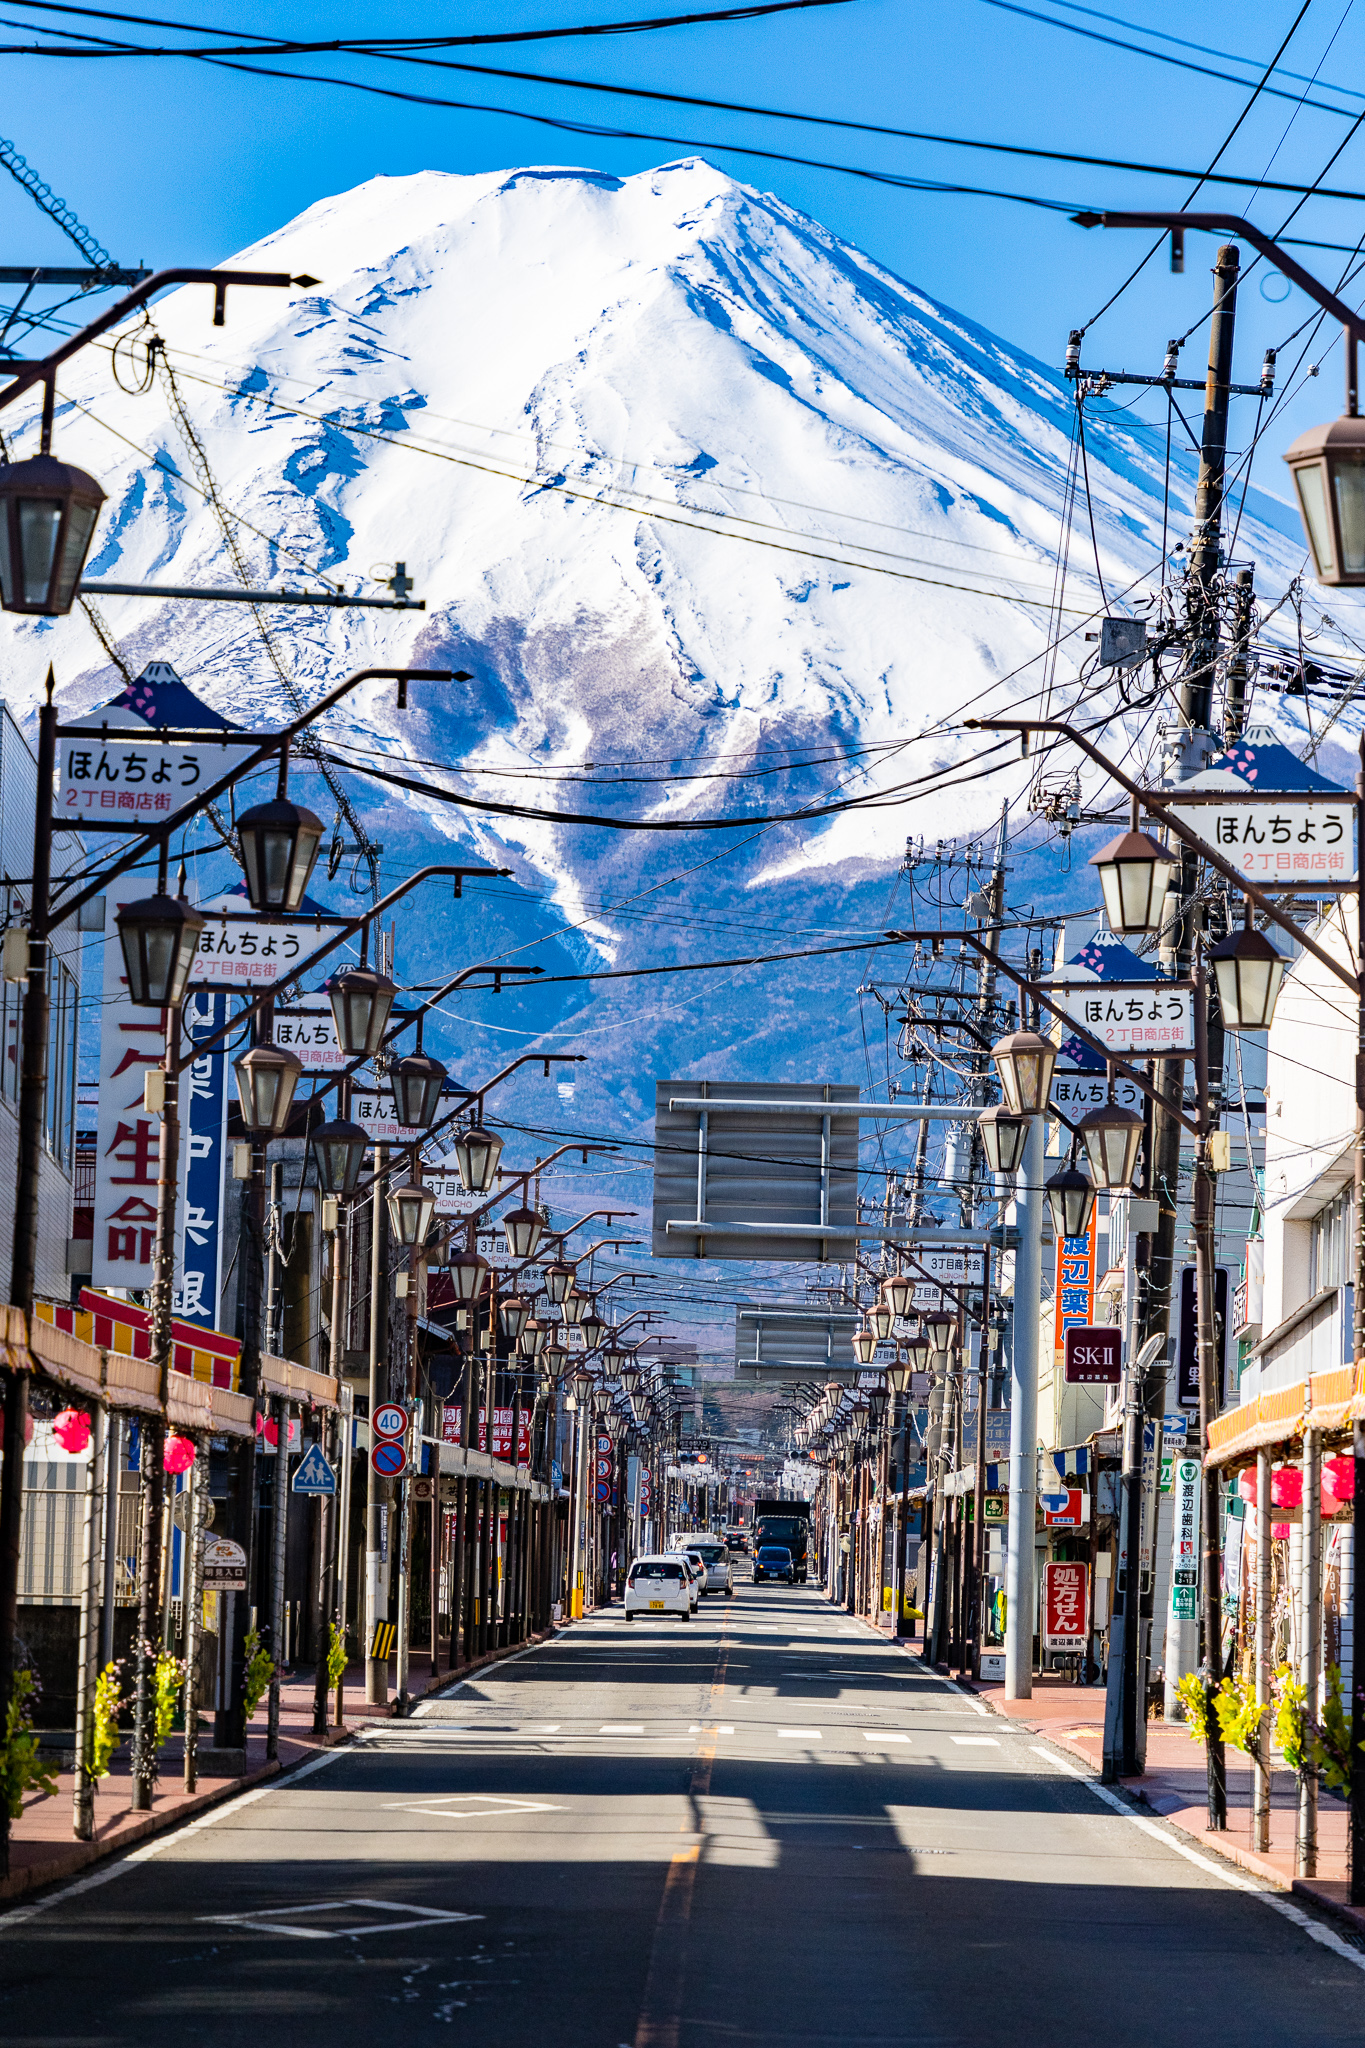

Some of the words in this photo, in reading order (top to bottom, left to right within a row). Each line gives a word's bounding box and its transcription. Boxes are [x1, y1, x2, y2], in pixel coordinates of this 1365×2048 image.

[68, 750, 201, 787] ほんちょう
[65, 788, 172, 812] 2丁目商店街
[1216, 814, 1344, 845] ほんちょう
[1242, 852, 1345, 870] 2丁目商店街
[195, 930, 301, 959] ほんちょう
[194, 959, 278, 978] 2丁目商店街
[1085, 997, 1185, 1023] ほんちょう
[1105, 1026, 1185, 1042] 2丁目商店街
[488, 1255, 519, 1264] HONCHO
[931, 1257, 981, 1271] 3丁目商栄会
[502, 1268, 546, 1281] 3目商栄会
[508, 1281, 536, 1289] HNCHO
[1078, 1373, 1109, 1381] 渡辺薬局
[380, 1413, 400, 1430] 40
[1181, 1484, 1194, 1541] 渡辺歯科
[1053, 1567, 1080, 1632] 処方せん
[1050, 1638, 1082, 1647] 渡辺薬局
